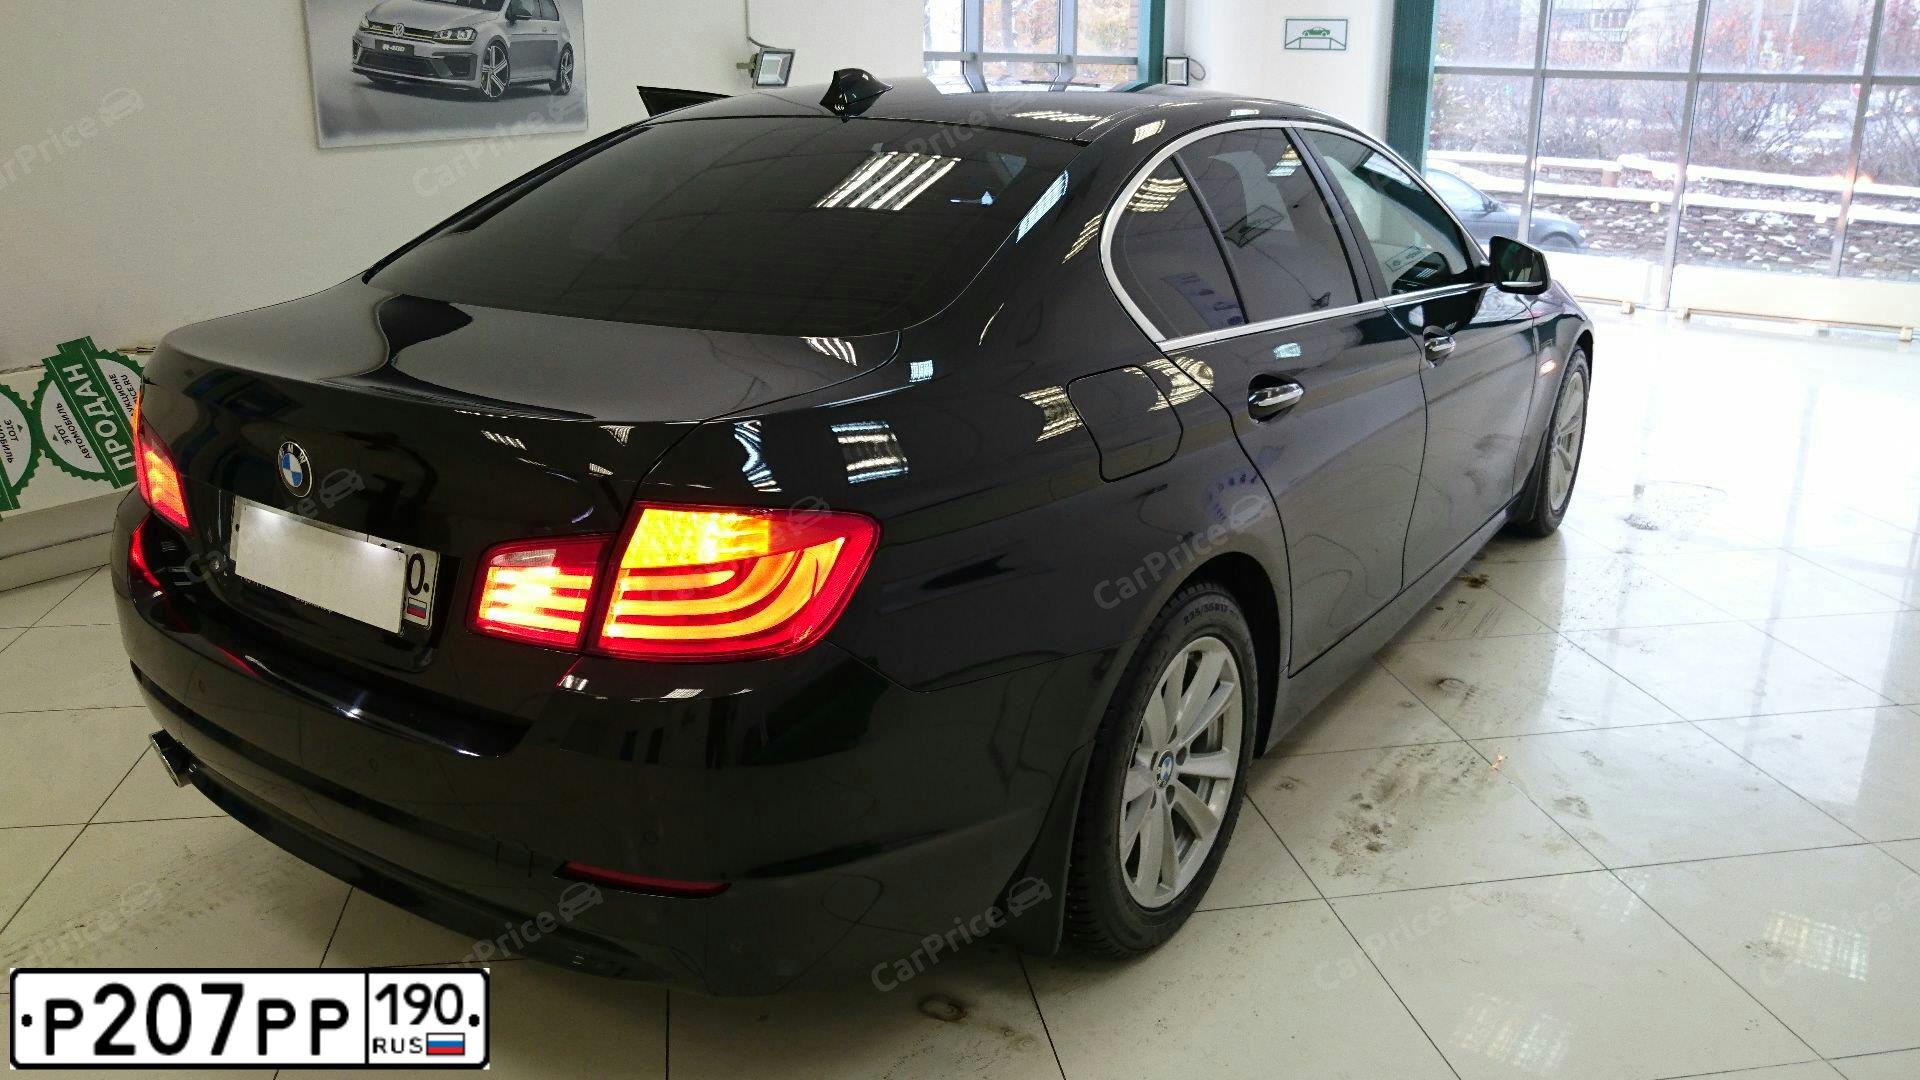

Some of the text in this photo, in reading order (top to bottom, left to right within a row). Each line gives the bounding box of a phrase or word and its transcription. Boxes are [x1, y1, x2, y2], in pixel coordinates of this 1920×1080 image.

[108, 373, 134, 416] УКЦИОНЕ
[4, 419, 20, 442] ЭТОТ
[54, 425, 73, 446] ЭТОТ
[56, 403, 92, 459] АВТОМОБИЛЬ
[62, 363, 136, 471] ПРОДАН
